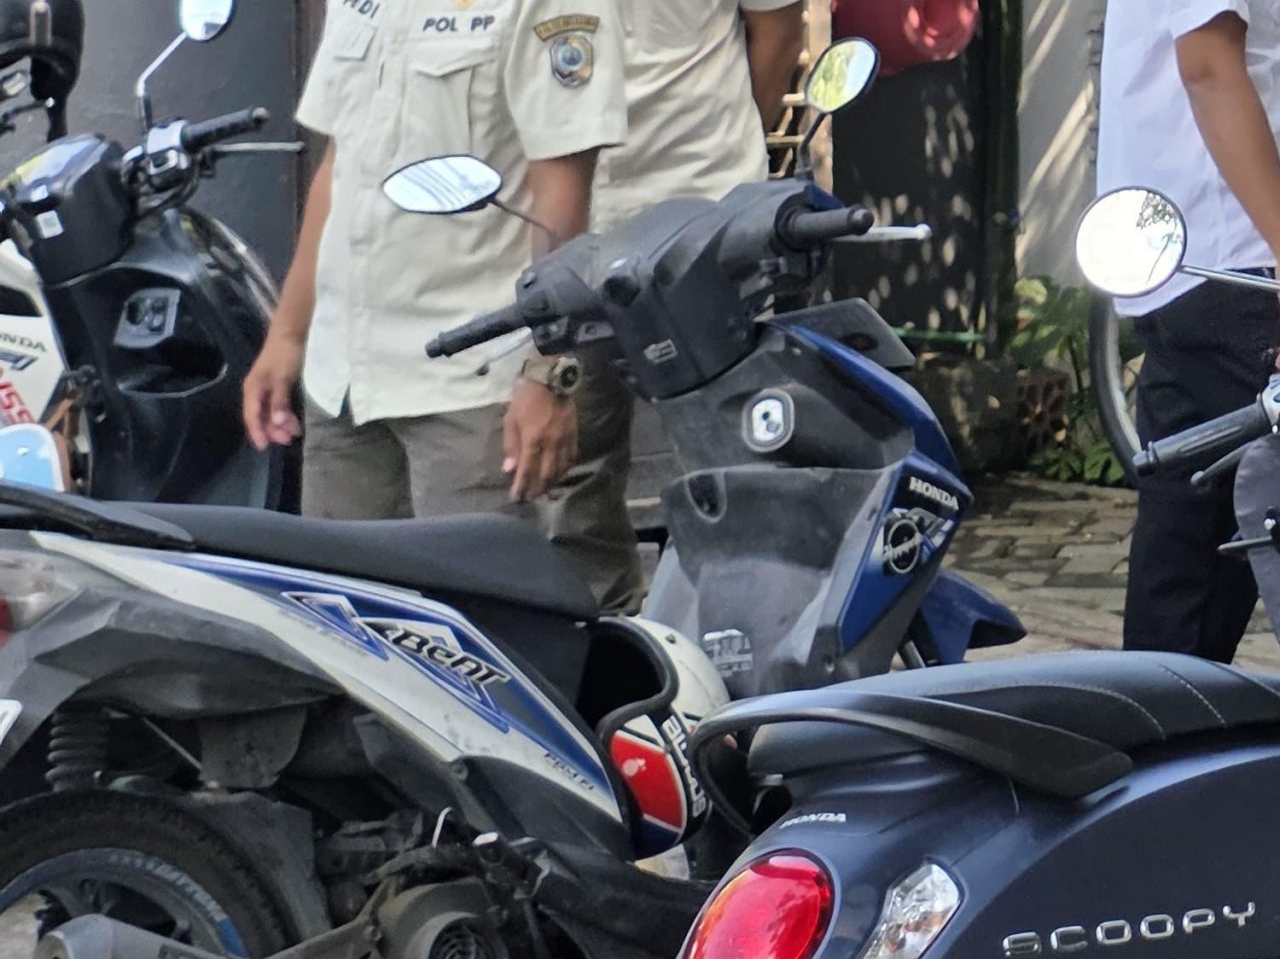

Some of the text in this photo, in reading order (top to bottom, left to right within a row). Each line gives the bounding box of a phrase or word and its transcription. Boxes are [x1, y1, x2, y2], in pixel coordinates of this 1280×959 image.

[422, 15, 496, 33] POL PP
[0, 331, 47, 354] NDA
[909, 476, 960, 511] HONDA
[780, 811, 848, 829] HONDA
[1001, 901, 1257, 957] SCOOPY
